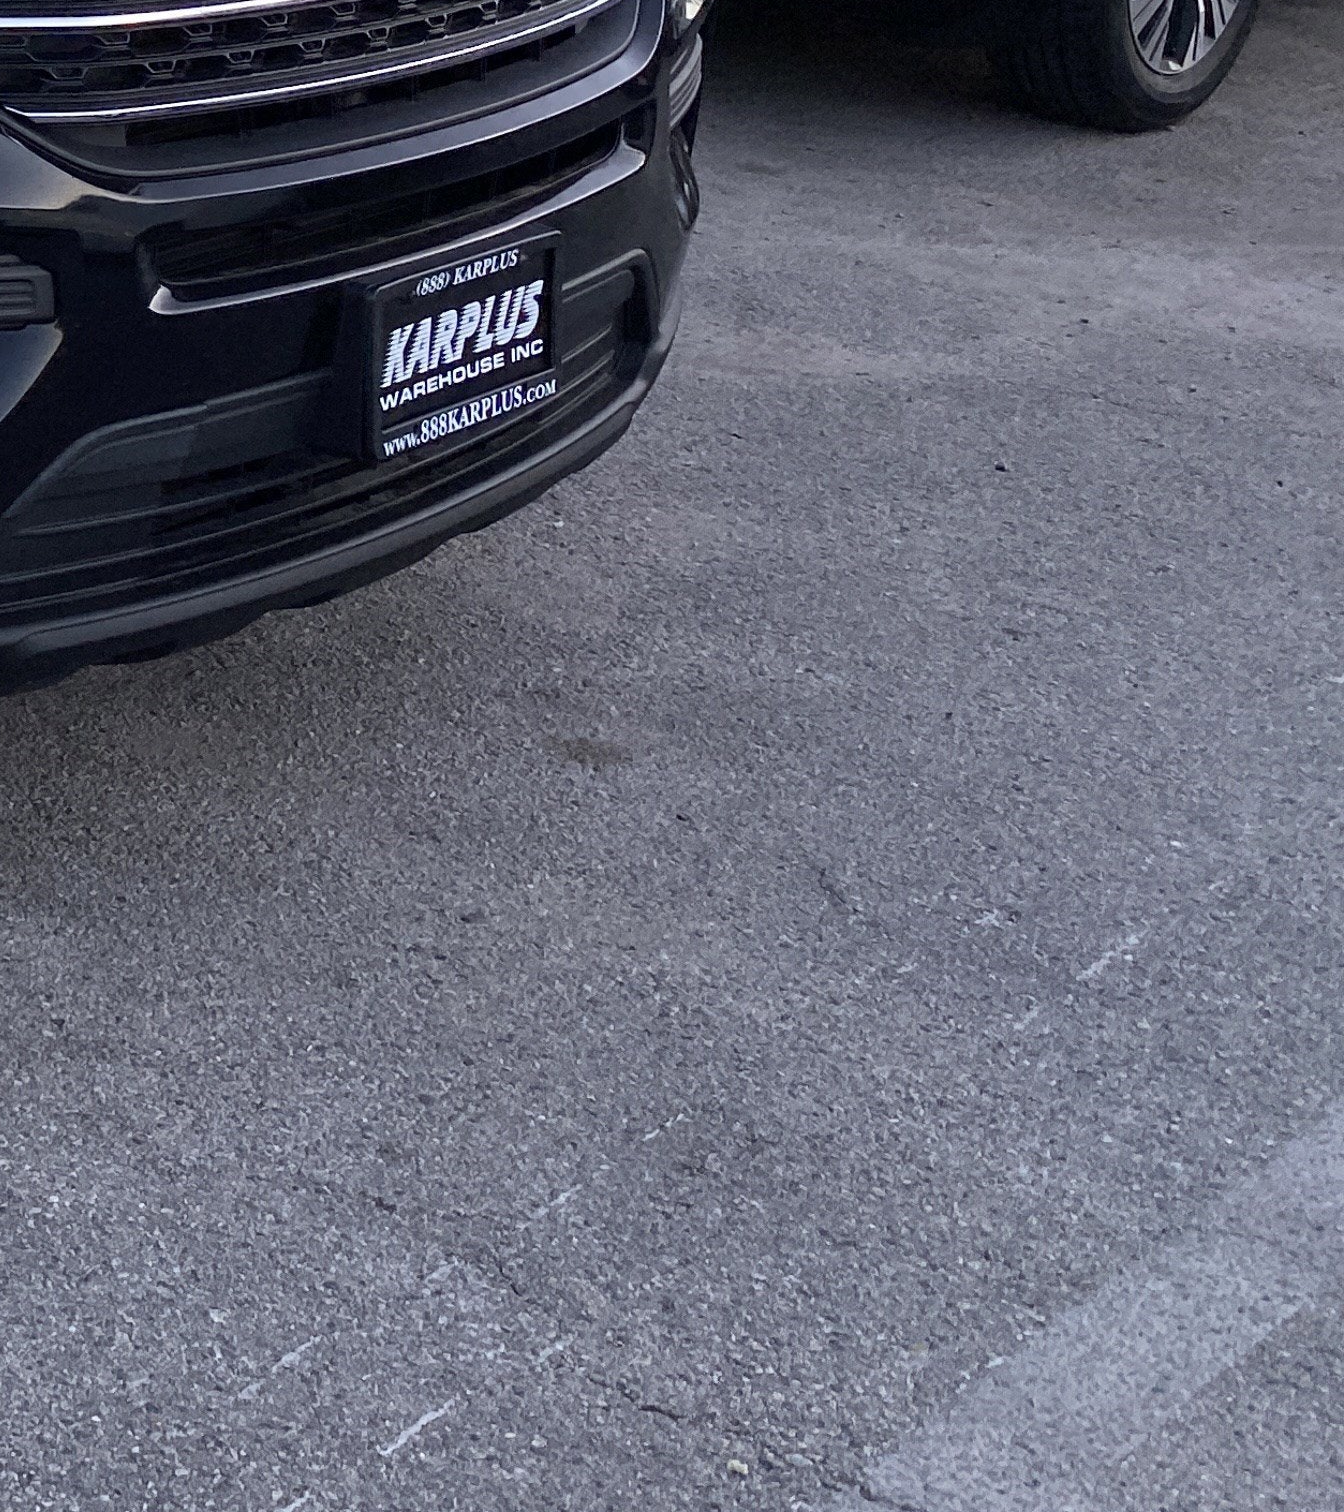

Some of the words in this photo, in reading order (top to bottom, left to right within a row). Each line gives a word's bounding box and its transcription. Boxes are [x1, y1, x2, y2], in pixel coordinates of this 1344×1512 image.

[416, 273, 450, 296] (888)
[452, 249, 519, 286] KARPLUS
[379, 279, 544, 389] KARPLUS
[378, 352, 506, 412] WAREHOUSE
[511, 338, 544, 364] INC
